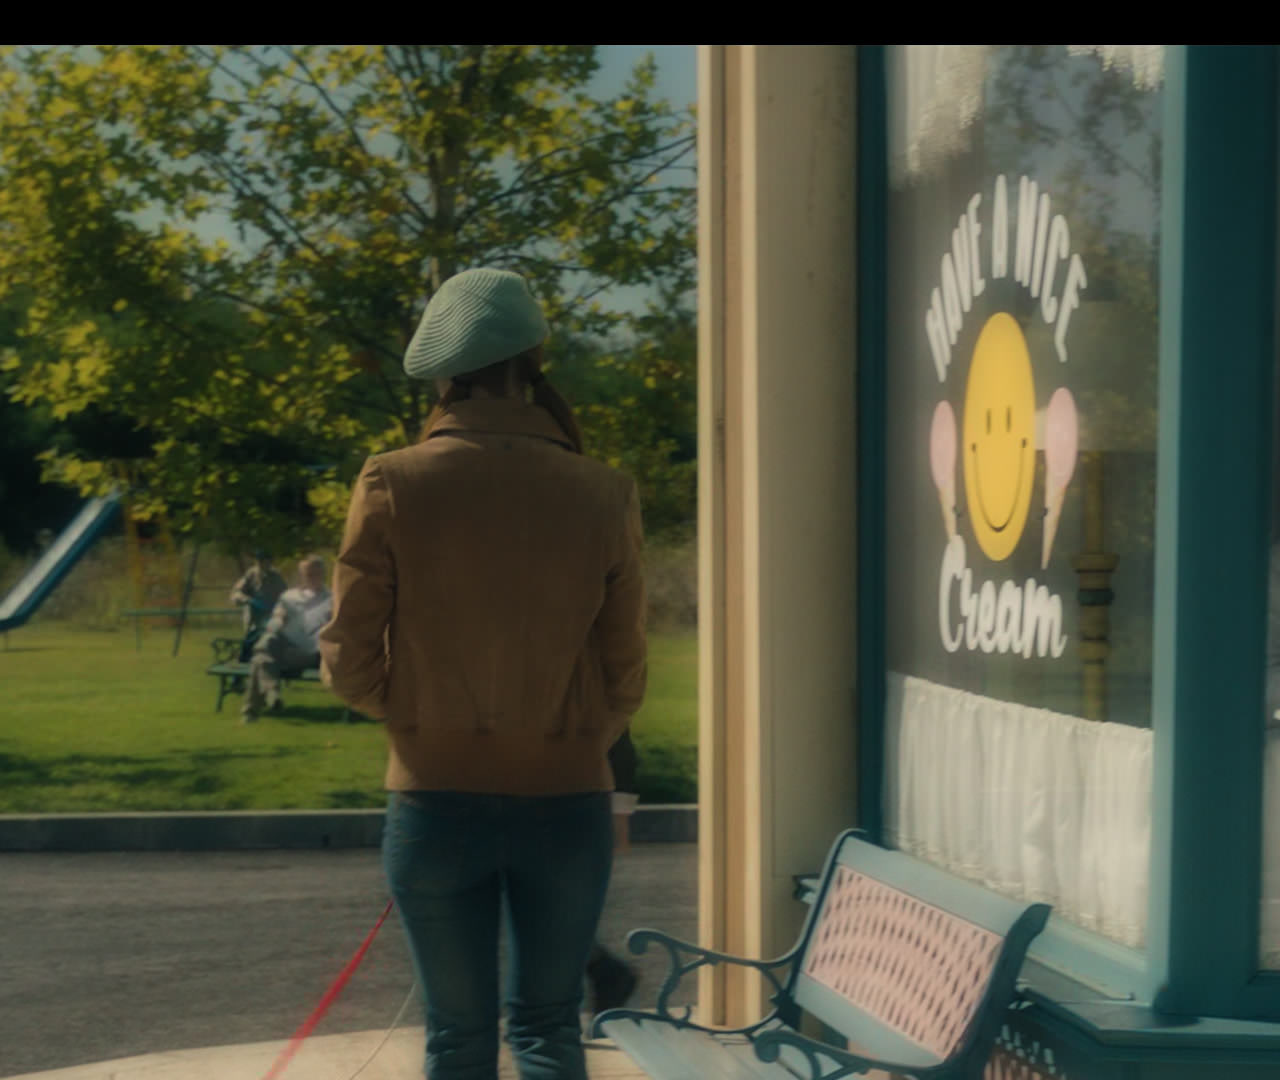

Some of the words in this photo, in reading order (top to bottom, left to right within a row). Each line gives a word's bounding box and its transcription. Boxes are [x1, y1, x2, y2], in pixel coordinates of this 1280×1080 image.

[925, 192, 986, 383] HAVE
[991, 173, 1009, 280] A
[1013, 174, 1088, 363] NICE
[938, 534, 1068, 660] Cream
